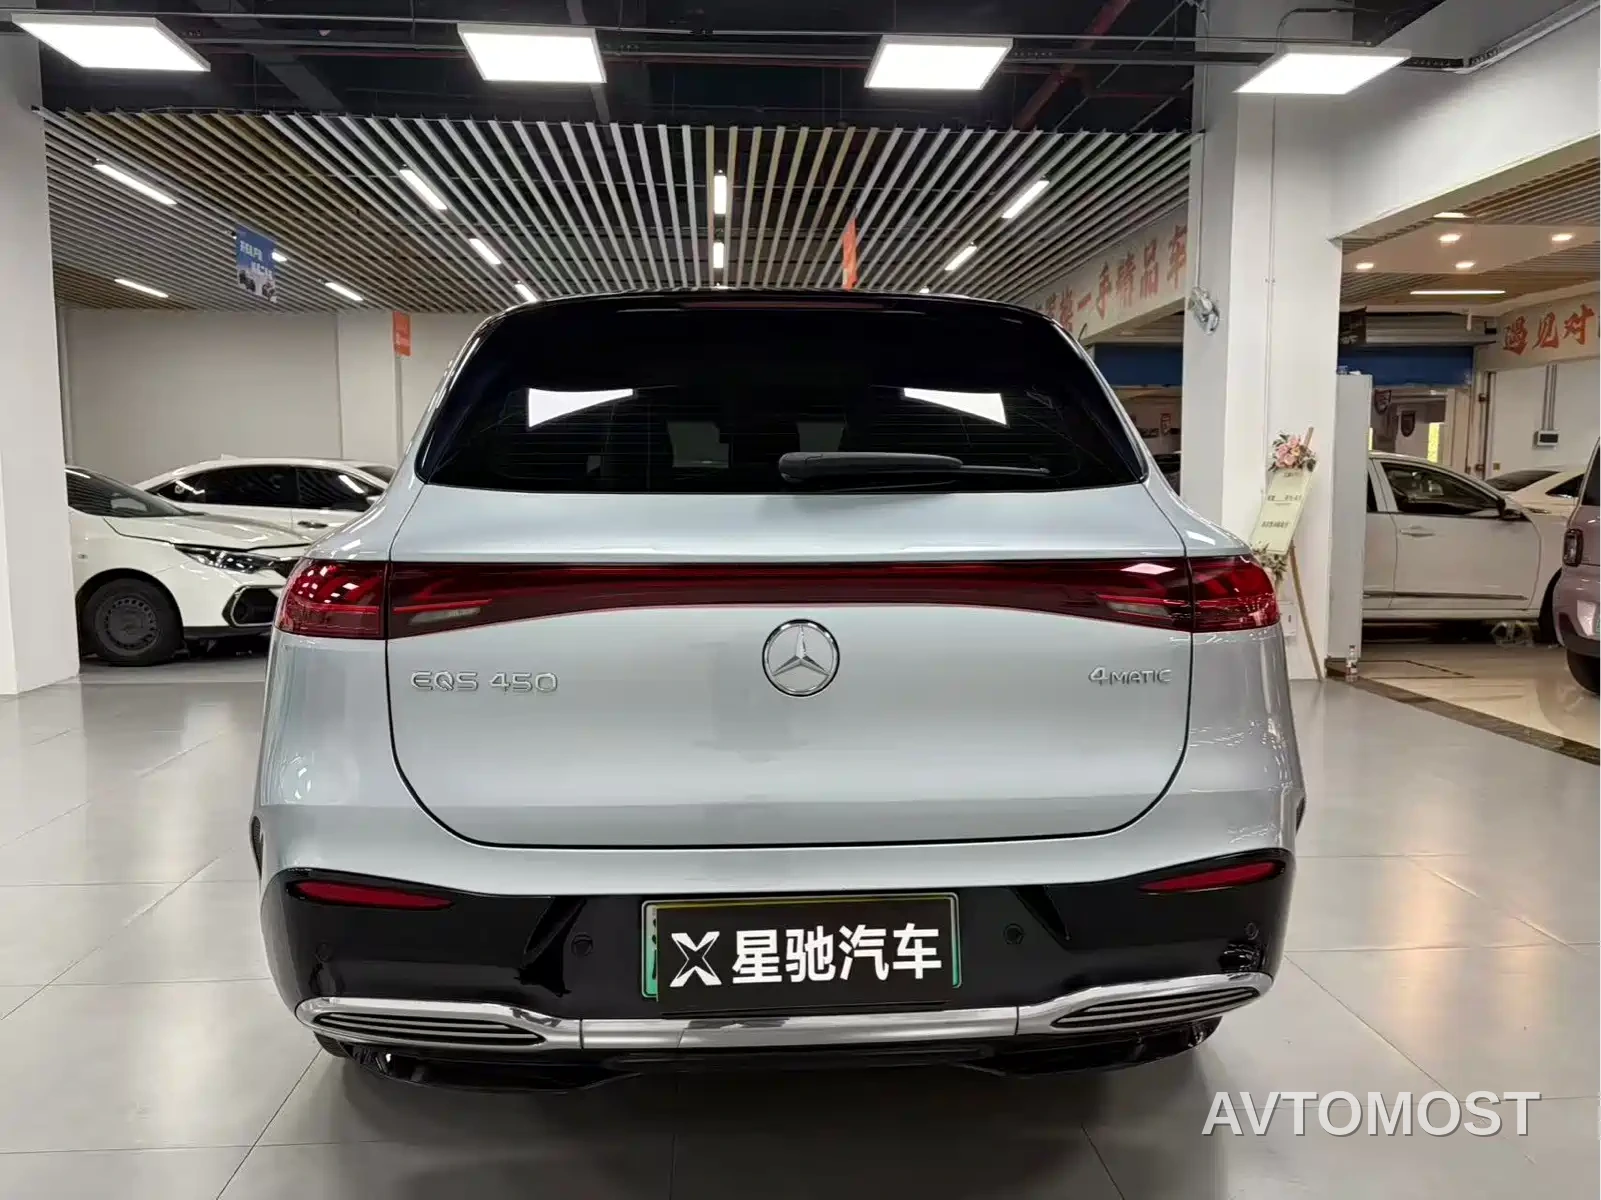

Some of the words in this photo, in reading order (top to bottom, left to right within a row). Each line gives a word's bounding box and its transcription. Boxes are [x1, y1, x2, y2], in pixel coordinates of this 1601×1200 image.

[410, 671, 479, 692] EQS
[489, 671, 558, 693] 450
[1088, 665, 1172, 686] 4MATIC
[732, 923, 942, 984] 星驰汽车
